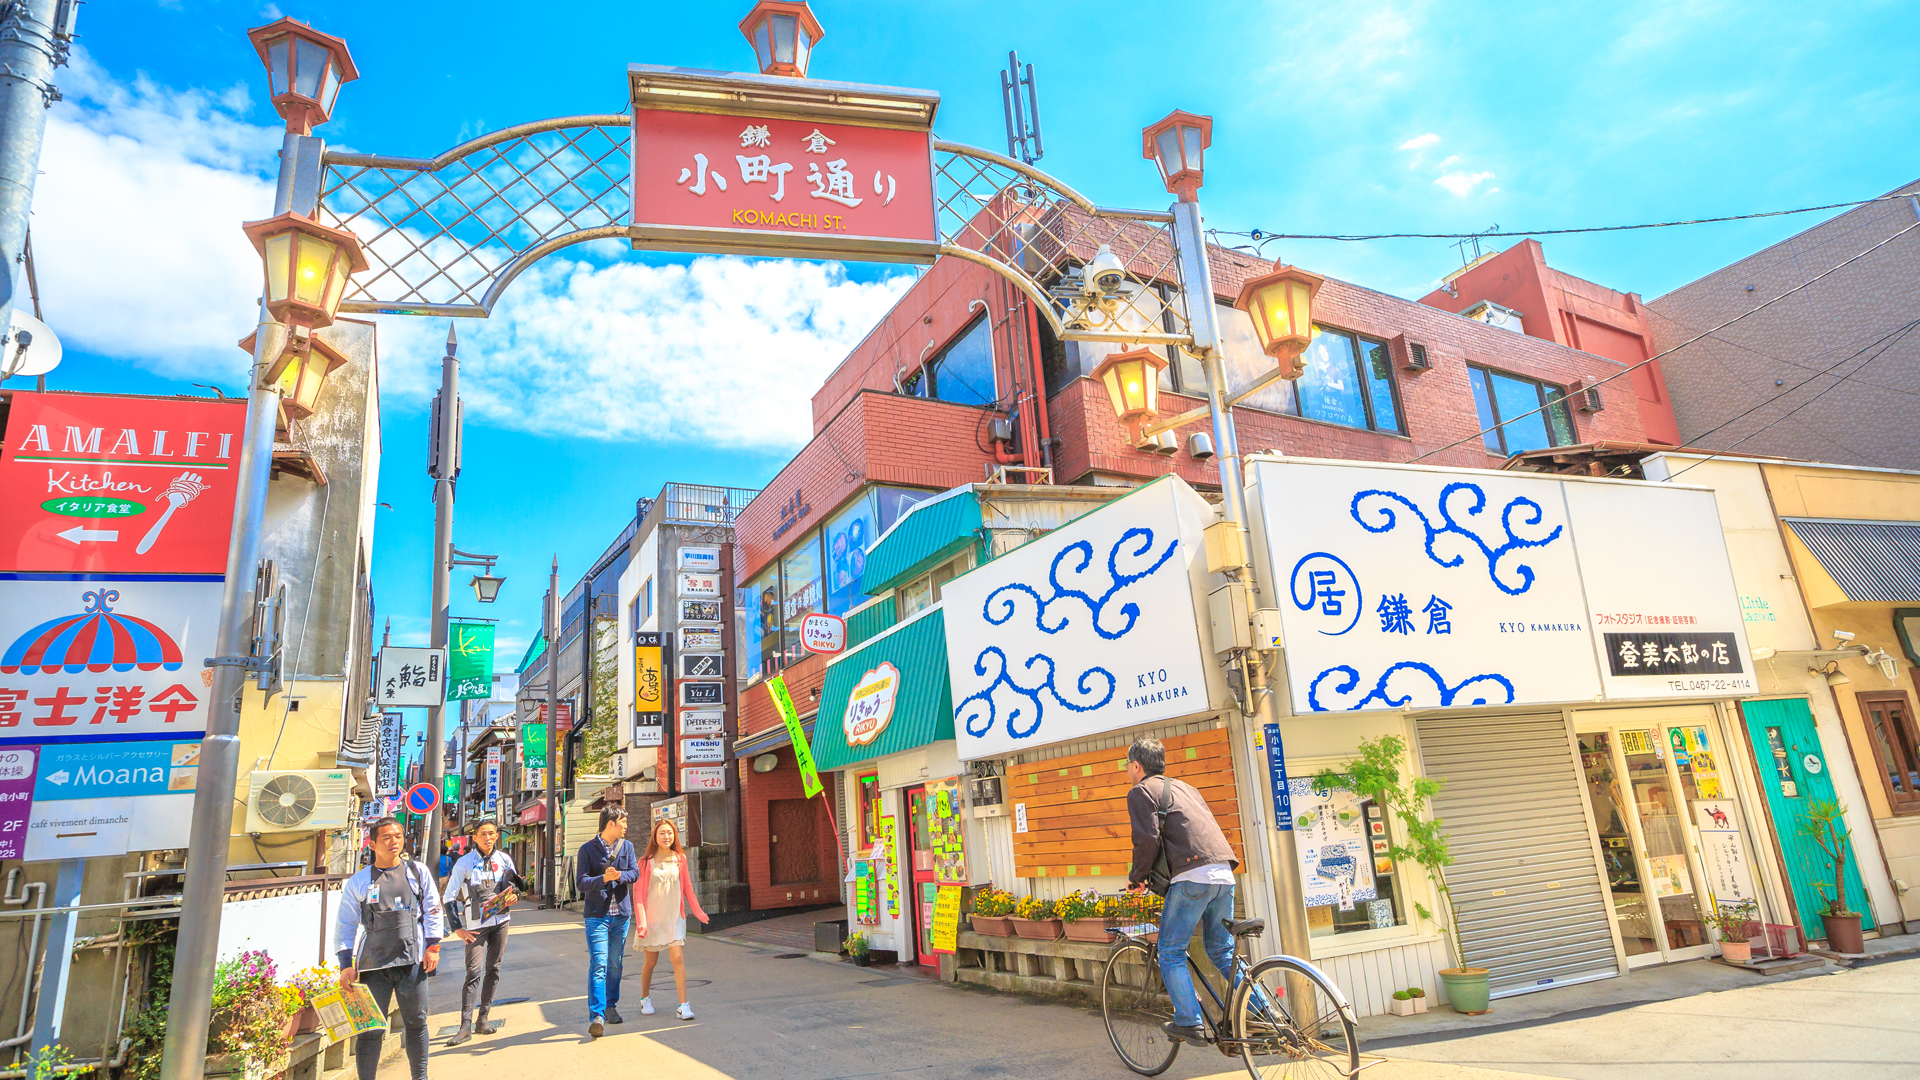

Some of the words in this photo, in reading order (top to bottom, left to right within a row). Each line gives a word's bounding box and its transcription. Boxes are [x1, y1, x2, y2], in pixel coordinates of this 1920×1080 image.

[739, 124, 836, 154] 鎌倉
[677, 152, 896, 208] 小町通り
[732, 208, 818, 229] KOMACHI
[823, 214, 848, 231] ST.
[18, 424, 234, 459] AMALFI
[47, 468, 152, 493] Kitchen
[56, 501, 132, 514] イタリア食堂
[687, 579, 713, 588] 写真
[1740, 596, 1769, 610] Little
[1376, 593, 1454, 636] 鎌倉
[1596, 613, 1643, 625] フォトスタジオ
[808, 619, 829, 627] かまくら
[1499, 622, 1526, 634] KYO
[1530, 623, 1582, 633] KAMAKURA
[807, 628, 833, 640] りきゅう
[812, 640, 836, 649] RIKYU
[1619, 640, 1731, 668] 登美太郎の店
[399, 663, 426, 689] 鮨
[708, 667, 717, 675] 2F
[1137, 668, 1169, 689] KYO
[1668, 680, 1751, 691] TEL.0467-22-4114
[690, 689, 703, 697] Yu
[704, 689, 716, 697] Li
[1126, 685, 1189, 710] KAMAKURA
[849, 694, 881, 724] りきゅう
[642, 714, 658, 725] 1F
[855, 718, 877, 735] RIKYU
[56, 751, 169, 762] ガラスとシルバーアクセサリー
[1271, 735, 1285, 790] 小町二丁目
[73, 765, 164, 787] Moana
[701, 777, 722, 788] てまり
[488, 768, 498, 808] 東洋食肉店
[1276, 794, 1289, 807] 10
[373, 802, 381, 814] 理容
[3, 820, 24, 832] 2F
[31, 819, 48, 829] café
[50, 818, 88, 828] vivement
[89, 815, 129, 826] dimanche
